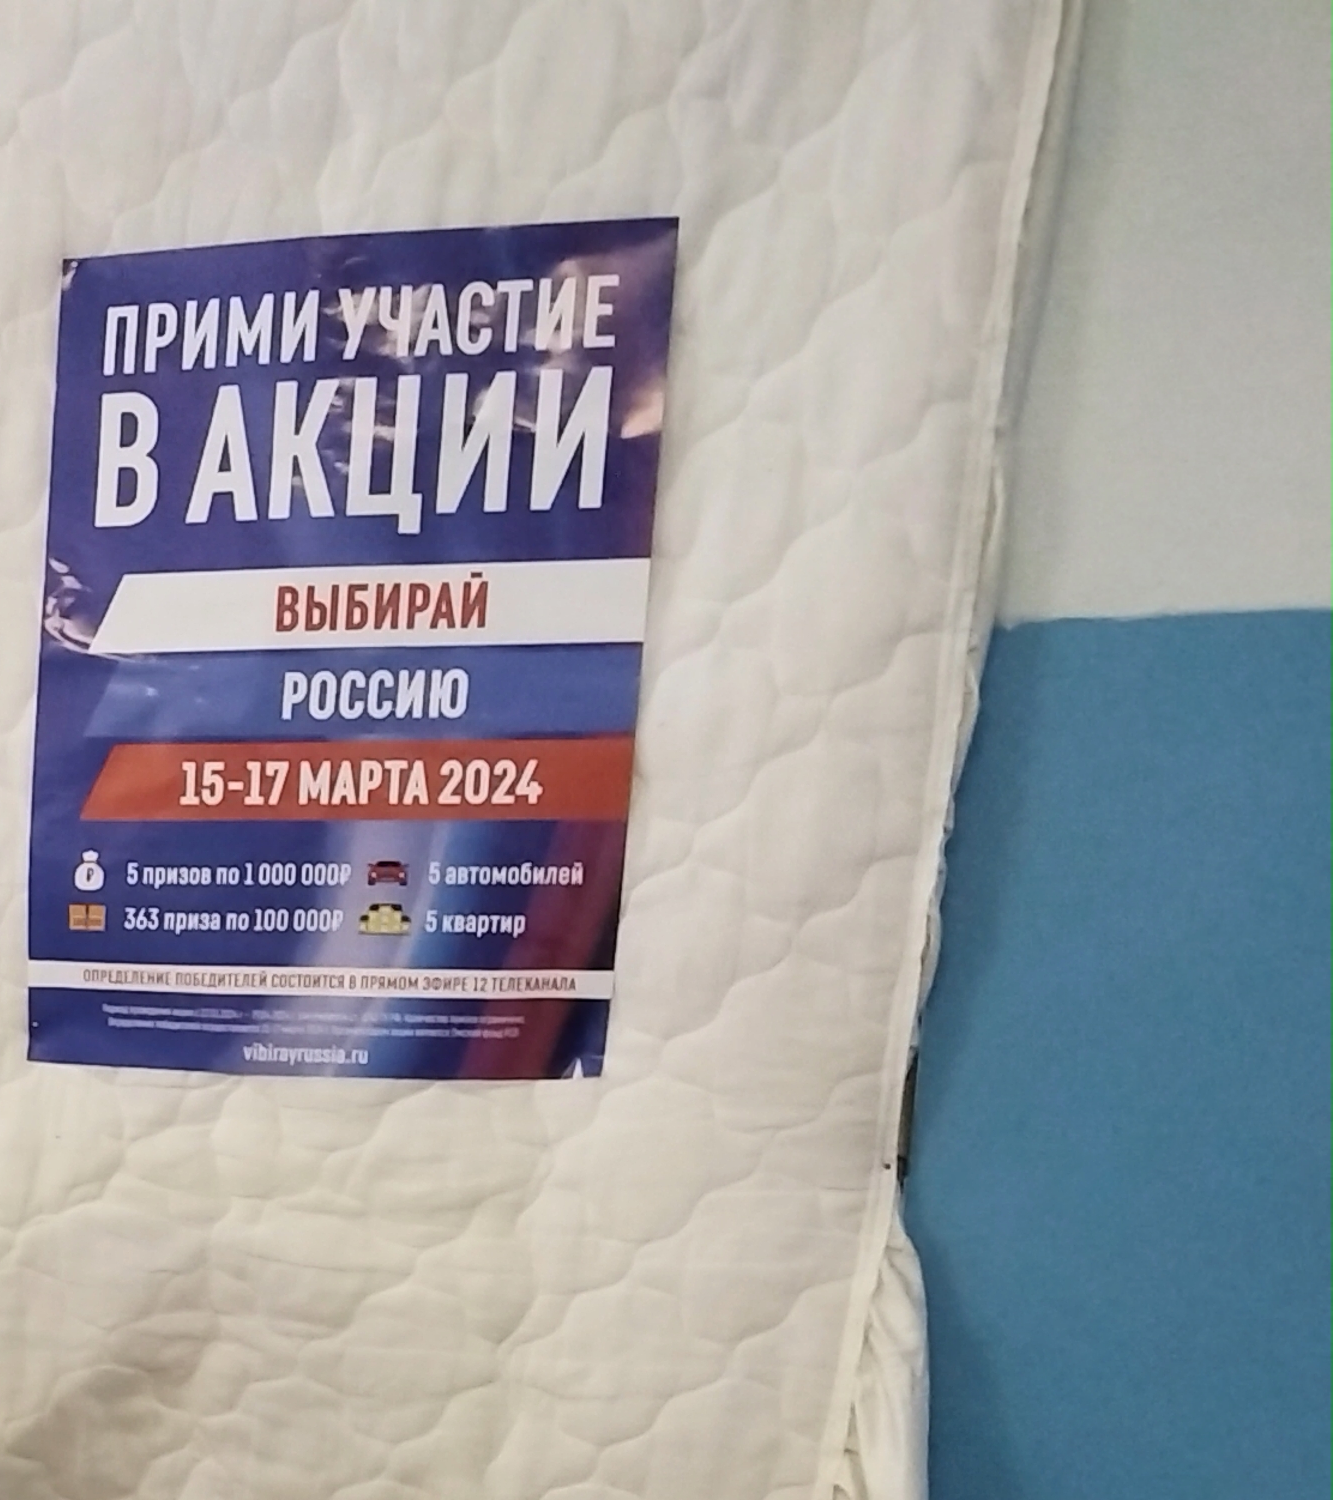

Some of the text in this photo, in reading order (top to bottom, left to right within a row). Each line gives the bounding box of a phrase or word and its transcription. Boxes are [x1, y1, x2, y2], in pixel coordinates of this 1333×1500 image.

[101, 274, 620, 376] ПРИМИ УЧАСТИЕ
[93, 365, 614, 535] В АКЦИИ
[275, 571, 488, 632] ВЫБИРАЙ
[280, 667, 470, 722] РОССИЮ
[178, 758, 544, 807] 15-17 МАРТА 2024
[126, 862, 139, 886] 5
[142, 866, 212, 889] призов
[216, 867, 240, 886] по
[243, 863, 254, 886] 1
[258, 863, 297, 886] 000
[428, 861, 584, 886] 5 автомобилей
[123, 907, 160, 931] 363
[163, 911, 221, 935] приза
[225, 912, 250, 931] по
[253, 908, 289, 932] 100
[425, 910, 526, 938] 5 квартир
[83, 968, 577, 992] ОПРЕДЕЛЕНИЕ ПОБЕДИТЕЛЕЙ СОСТОИТСЯ В ПРЯМОМ ЭФИРЕ 12 ТЕЛЕКАНАЛА
